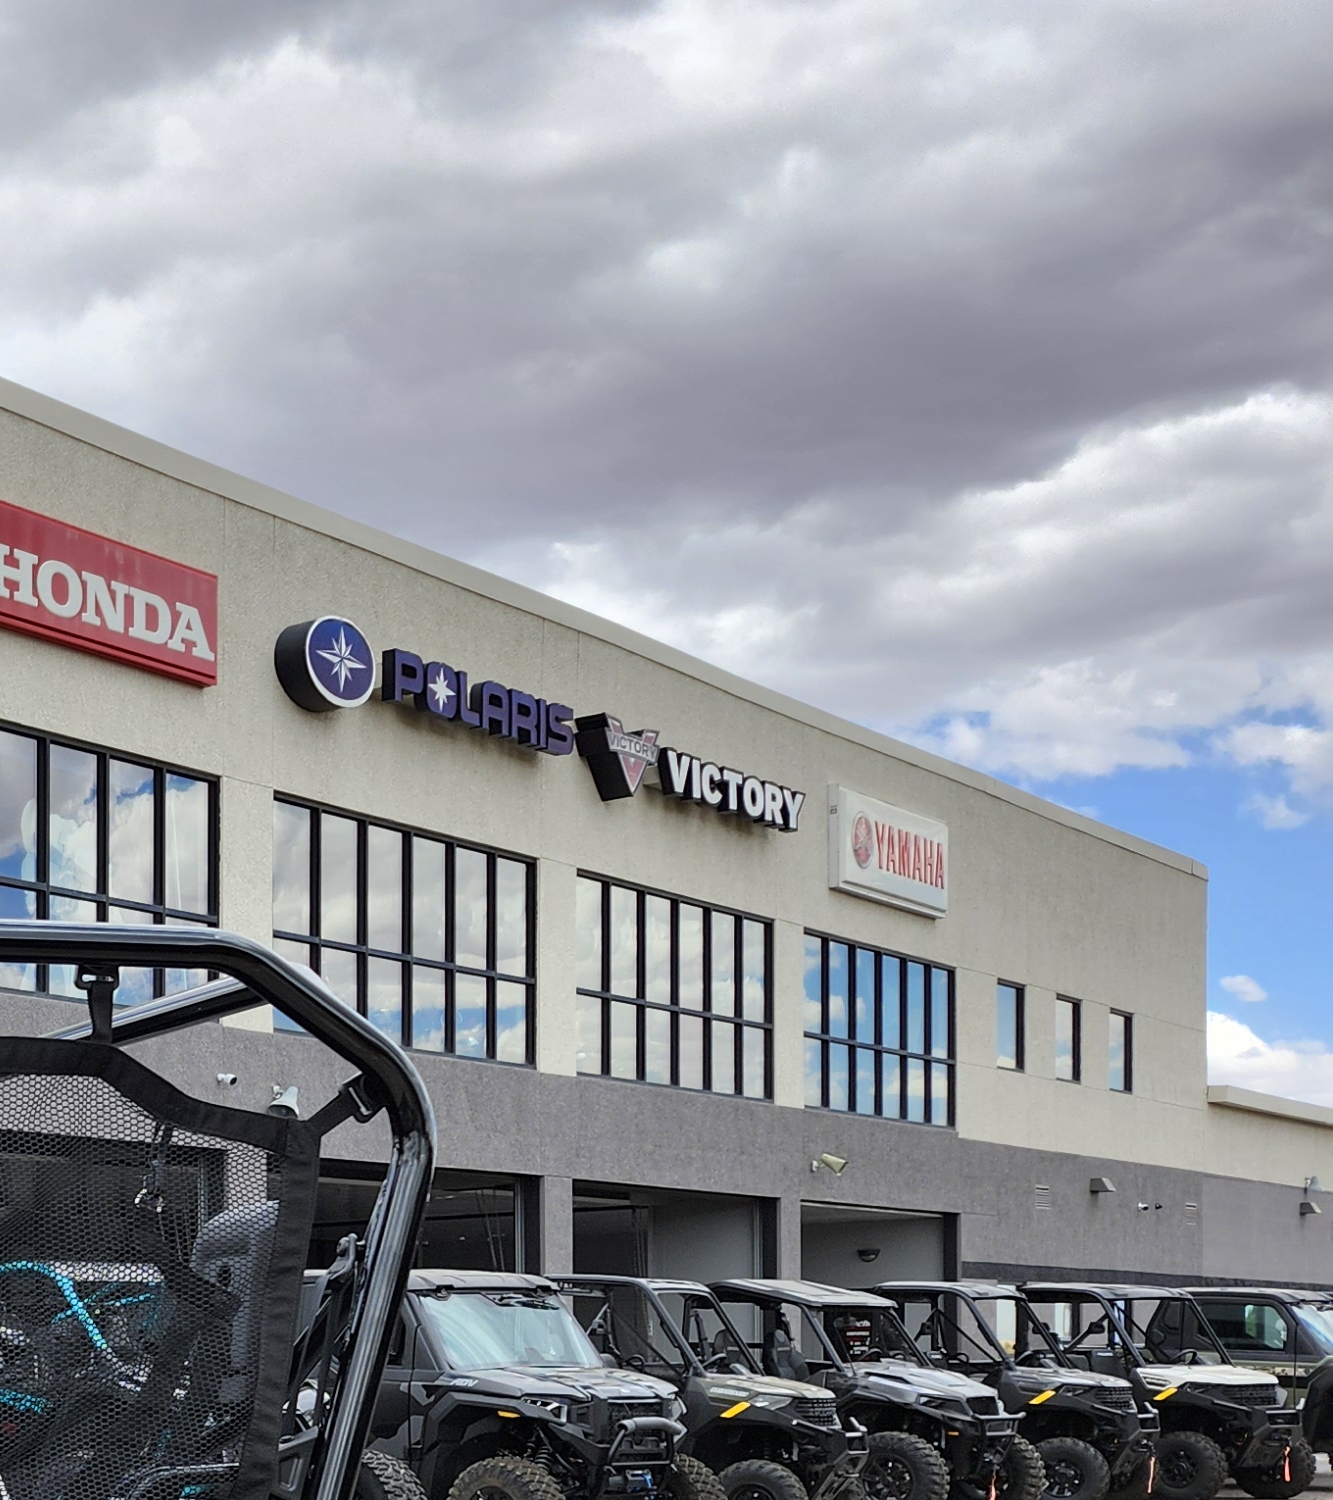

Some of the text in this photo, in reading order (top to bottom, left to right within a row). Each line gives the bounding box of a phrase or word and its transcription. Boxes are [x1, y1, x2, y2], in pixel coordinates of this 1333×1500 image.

[383, 647, 574, 757] POLARIS
[608, 732, 658, 757] VICTORY
[664, 747, 806, 832] VICTORY
[873, 819, 946, 890] YAMAHA
[449, 1378, 479, 1388] ADV
